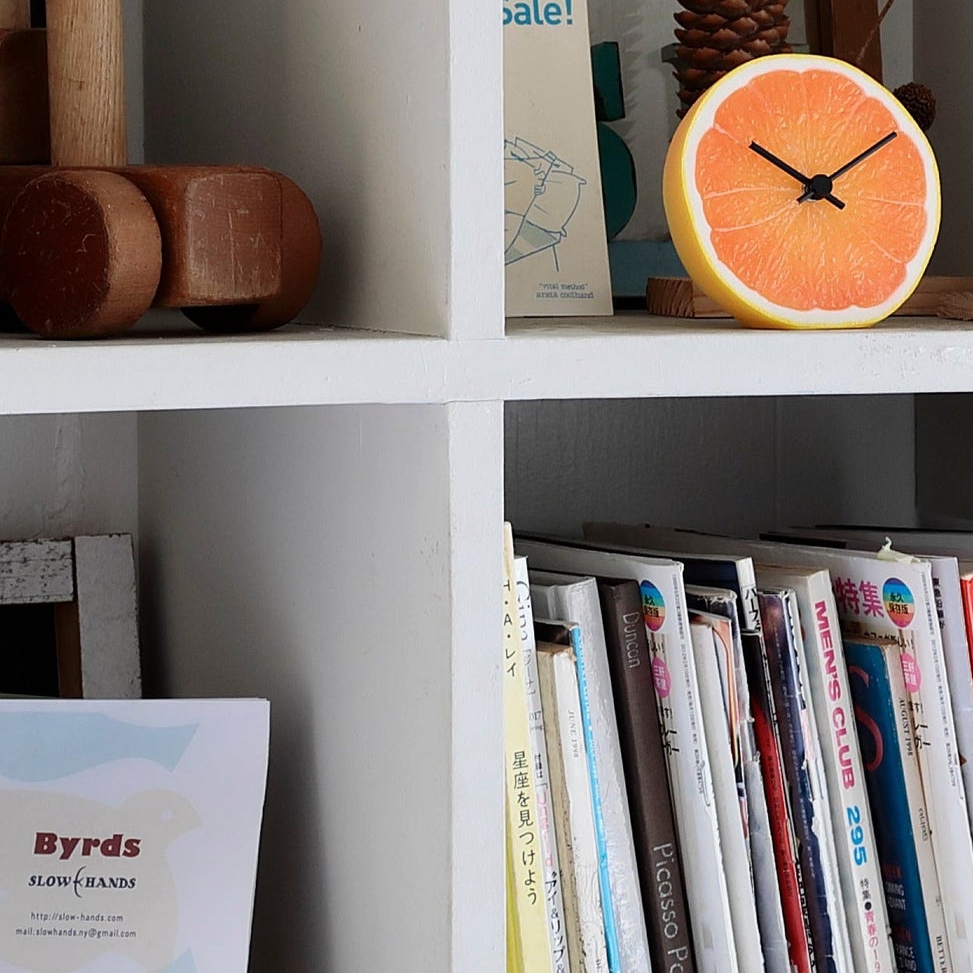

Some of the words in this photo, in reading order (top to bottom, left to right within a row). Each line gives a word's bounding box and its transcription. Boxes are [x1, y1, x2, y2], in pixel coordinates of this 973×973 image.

[835, 577, 885, 618] 特集
[814, 601, 842, 702] MEN'S
[832, 707, 855, 790] CLUB
[847, 805, 868, 867] 295
[623, 612, 641, 668] Duncan
[653, 842, 679, 939] Picasso
[512, 751, 538, 905] 星座を見つけよう
[34, 832, 142, 860] Byrds
[28, 875, 72, 887] SLOW
[85, 877, 137, 889] HANDS
[15, 927, 137, 939] mail:slowhands.ny@gmail.com
[30, 911, 124, 923] http://slow-hands.com
